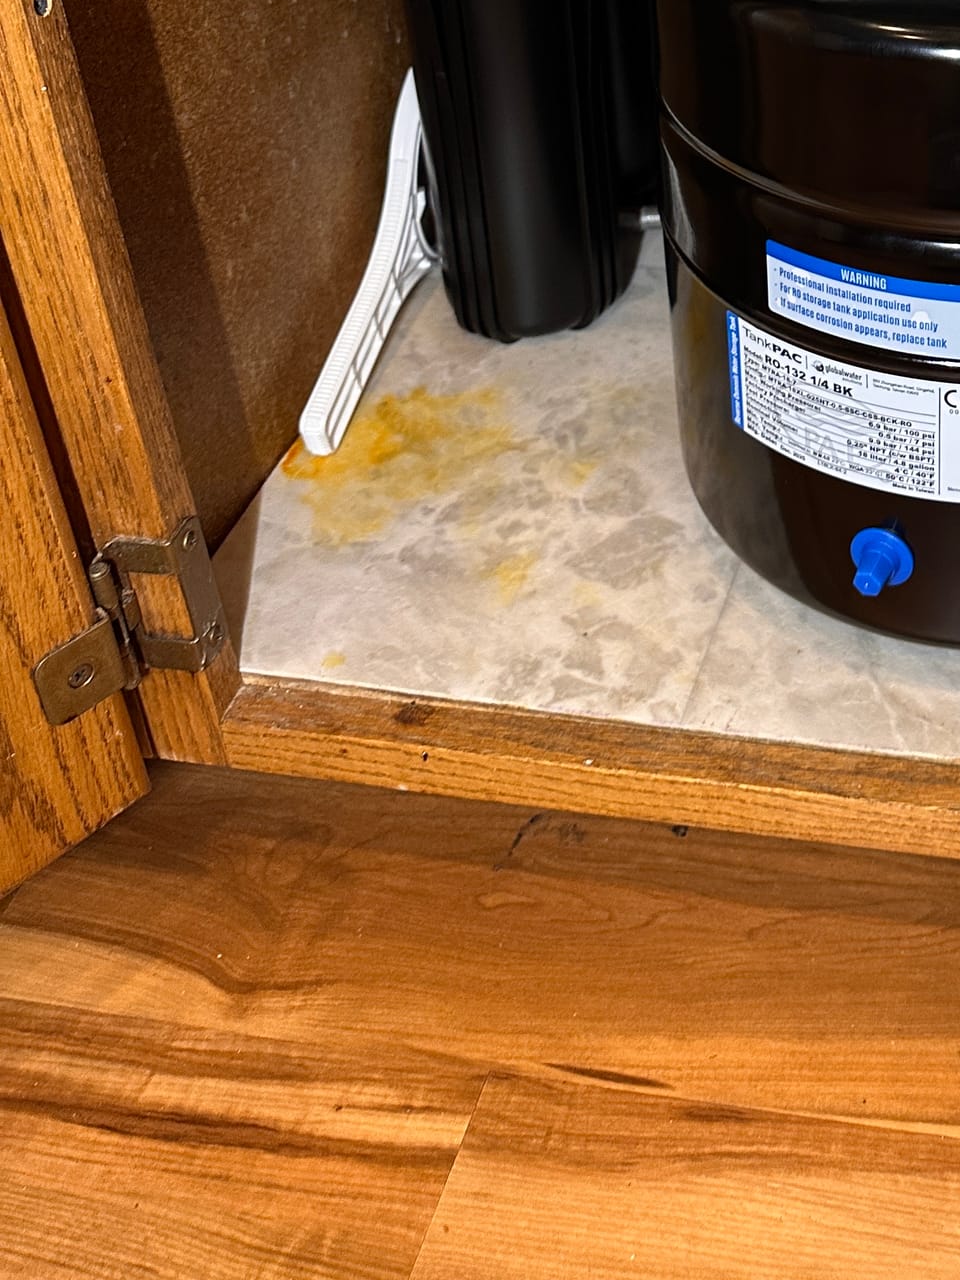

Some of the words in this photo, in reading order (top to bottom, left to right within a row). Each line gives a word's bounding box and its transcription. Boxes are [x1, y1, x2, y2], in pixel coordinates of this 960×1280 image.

[779, 267, 824, 292] Professional
[826, 281, 872, 305] installation
[874, 298, 911, 312] required
[841, 268, 887, 290] WARNING
[780, 283, 791, 294] For
[792, 287, 801, 298] RO
[803, 291, 831, 309] storage
[833, 299, 850, 314] tank
[852, 305, 899, 326] application
[902, 318, 917, 328] use
[919, 319, 938, 332] only
[780, 297, 786, 307] If
[787, 300, 814, 318] surface
[816, 311, 853, 330] corrosion
[855, 323, 890, 341] appears,
[892, 331, 924, 346] replace
[927, 336, 947, 348] tank
[742, 325, 801, 364] TankPAC
[765, 353, 805, 381] RO-132
[810, 374, 828, 389] 1/4
[833, 382, 852, 397] BK
[893, 434, 906, 442] bar
[922, 440, 934, 448] psi
[904, 429, 919, 437] 100
[922, 432, 934, 440] psi
[904, 445, 919, 453] 144
[922, 448, 934, 456] psi
[908, 461, 934, 472] gallon
